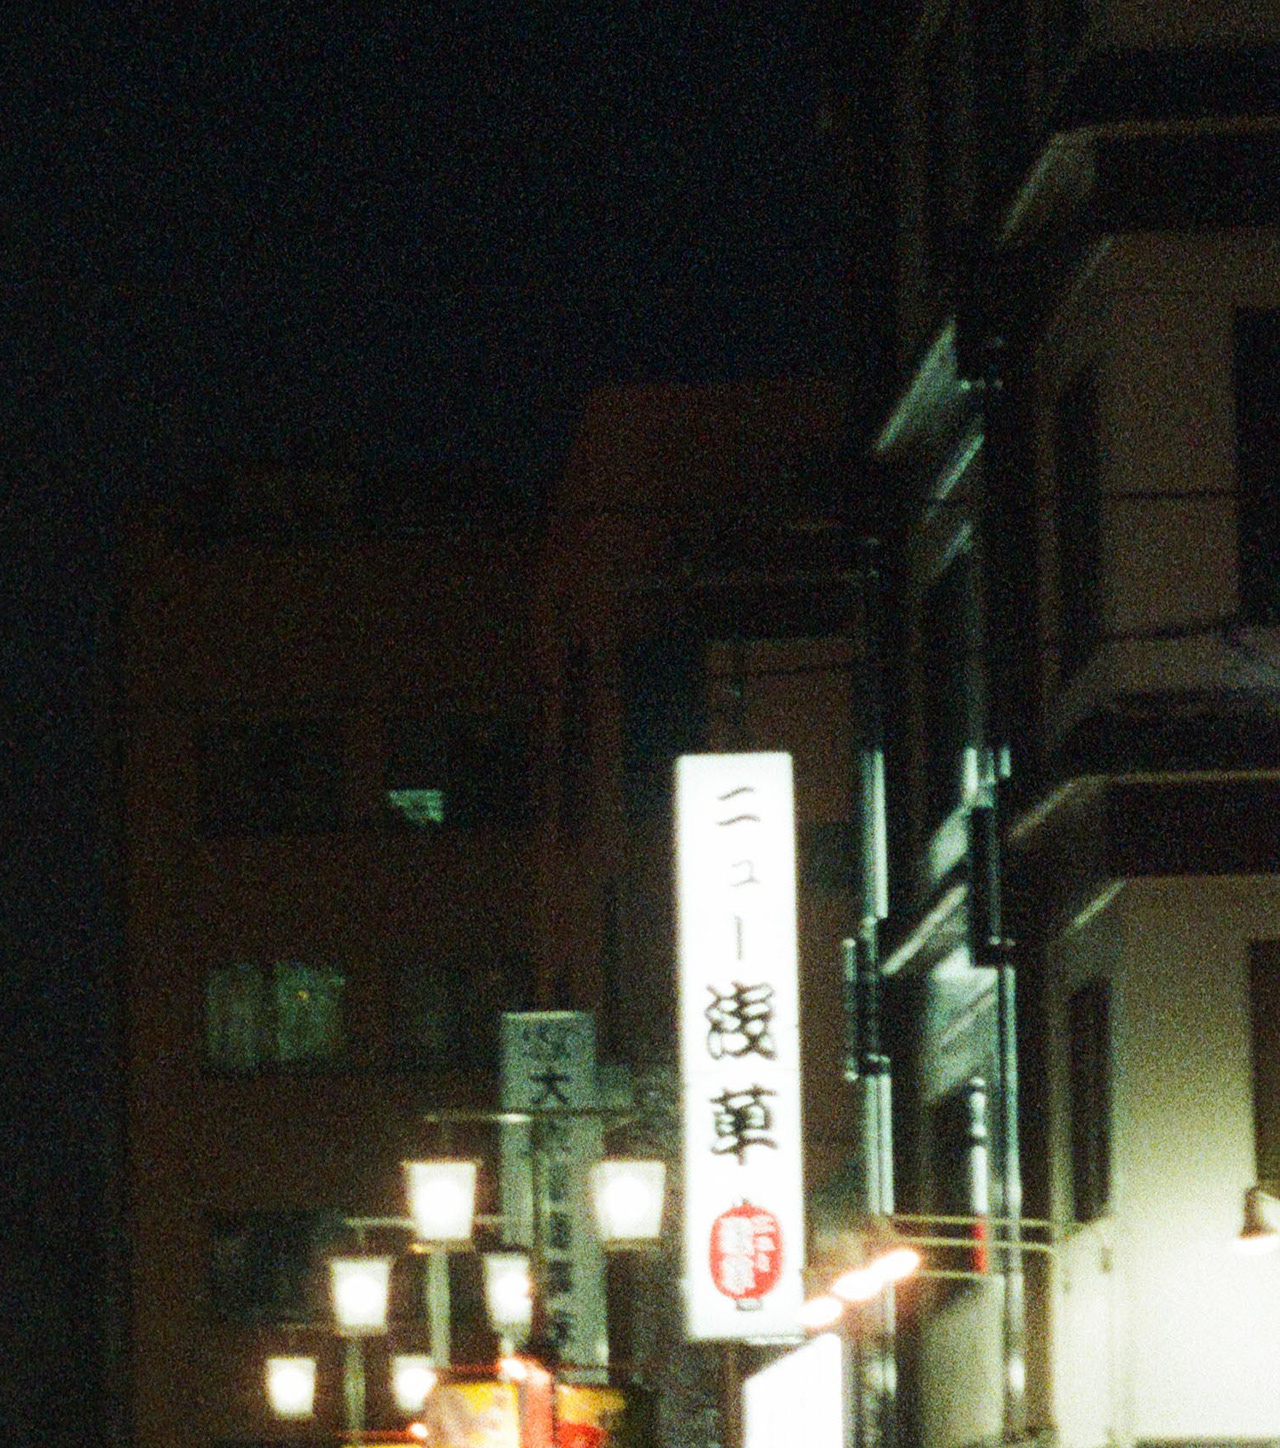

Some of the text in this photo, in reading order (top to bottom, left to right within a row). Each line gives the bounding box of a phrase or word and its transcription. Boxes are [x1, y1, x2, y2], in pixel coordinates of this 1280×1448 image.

[704, 786, 778, 1166] ニュー浅草
